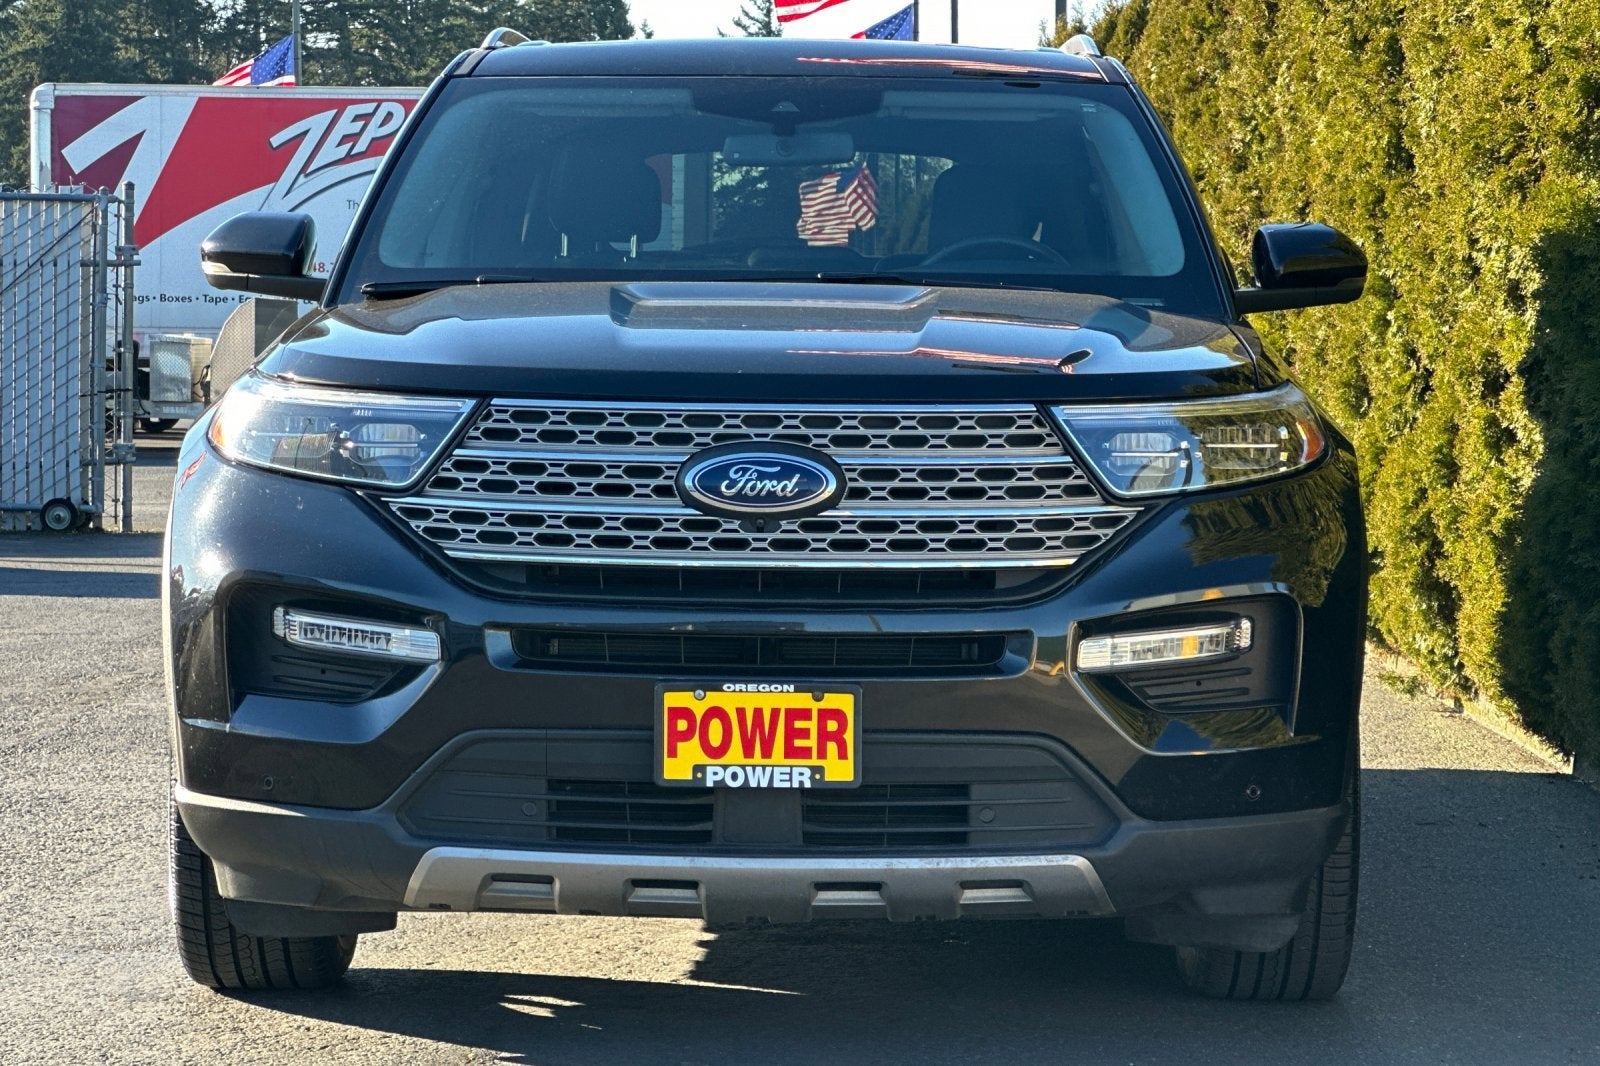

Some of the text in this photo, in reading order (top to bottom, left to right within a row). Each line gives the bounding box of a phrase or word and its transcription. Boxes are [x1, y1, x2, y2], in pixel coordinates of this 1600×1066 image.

[261, 101, 406, 211] ZEP
[160, 293, 193, 303] Boxes
[202, 294, 229, 305] Tape
[720, 464, 801, 497] Ford
[722, 683, 795, 693] OREGON
[666, 705, 849, 761] POWER
[706, 765, 812, 788] POWER
